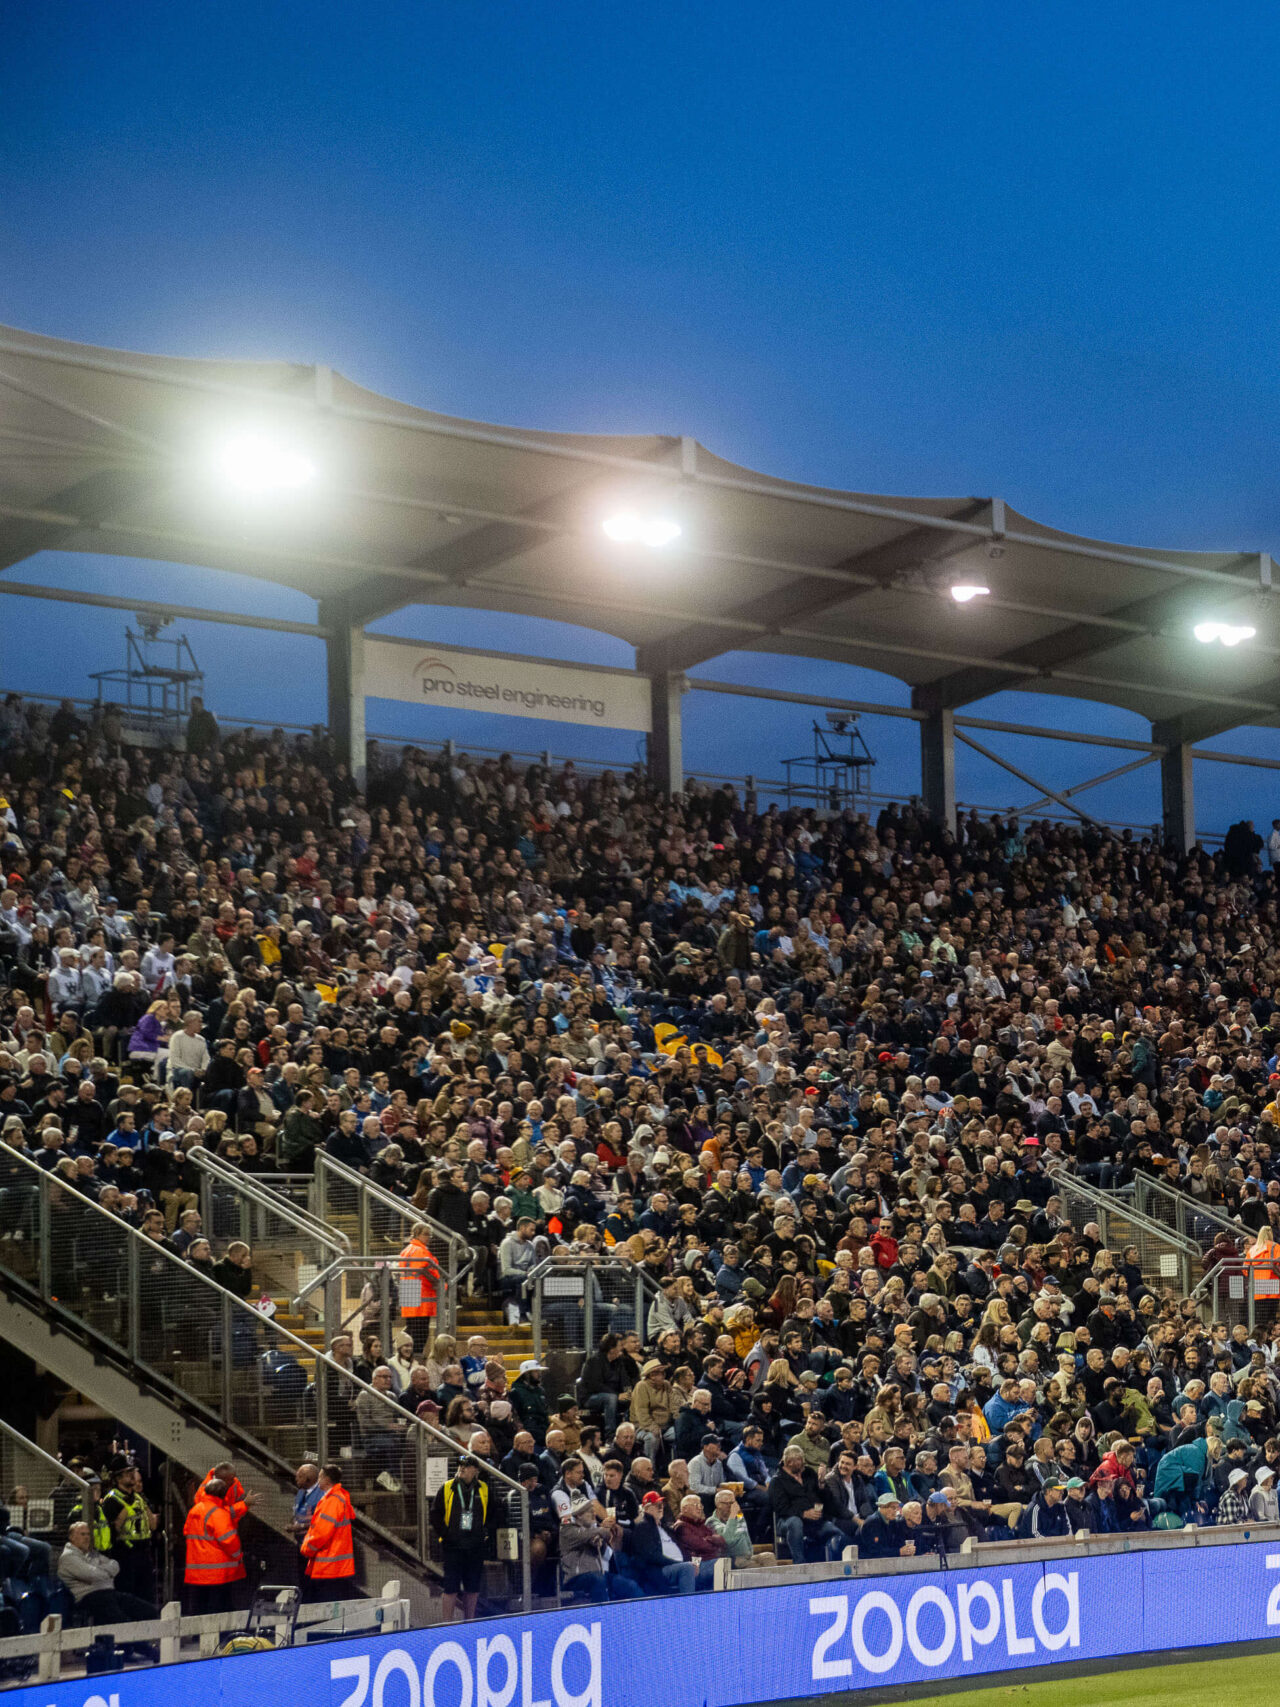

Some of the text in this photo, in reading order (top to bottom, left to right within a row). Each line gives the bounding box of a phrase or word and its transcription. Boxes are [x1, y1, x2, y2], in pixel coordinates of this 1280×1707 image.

[422, 675, 605, 717] pro steel engineering
